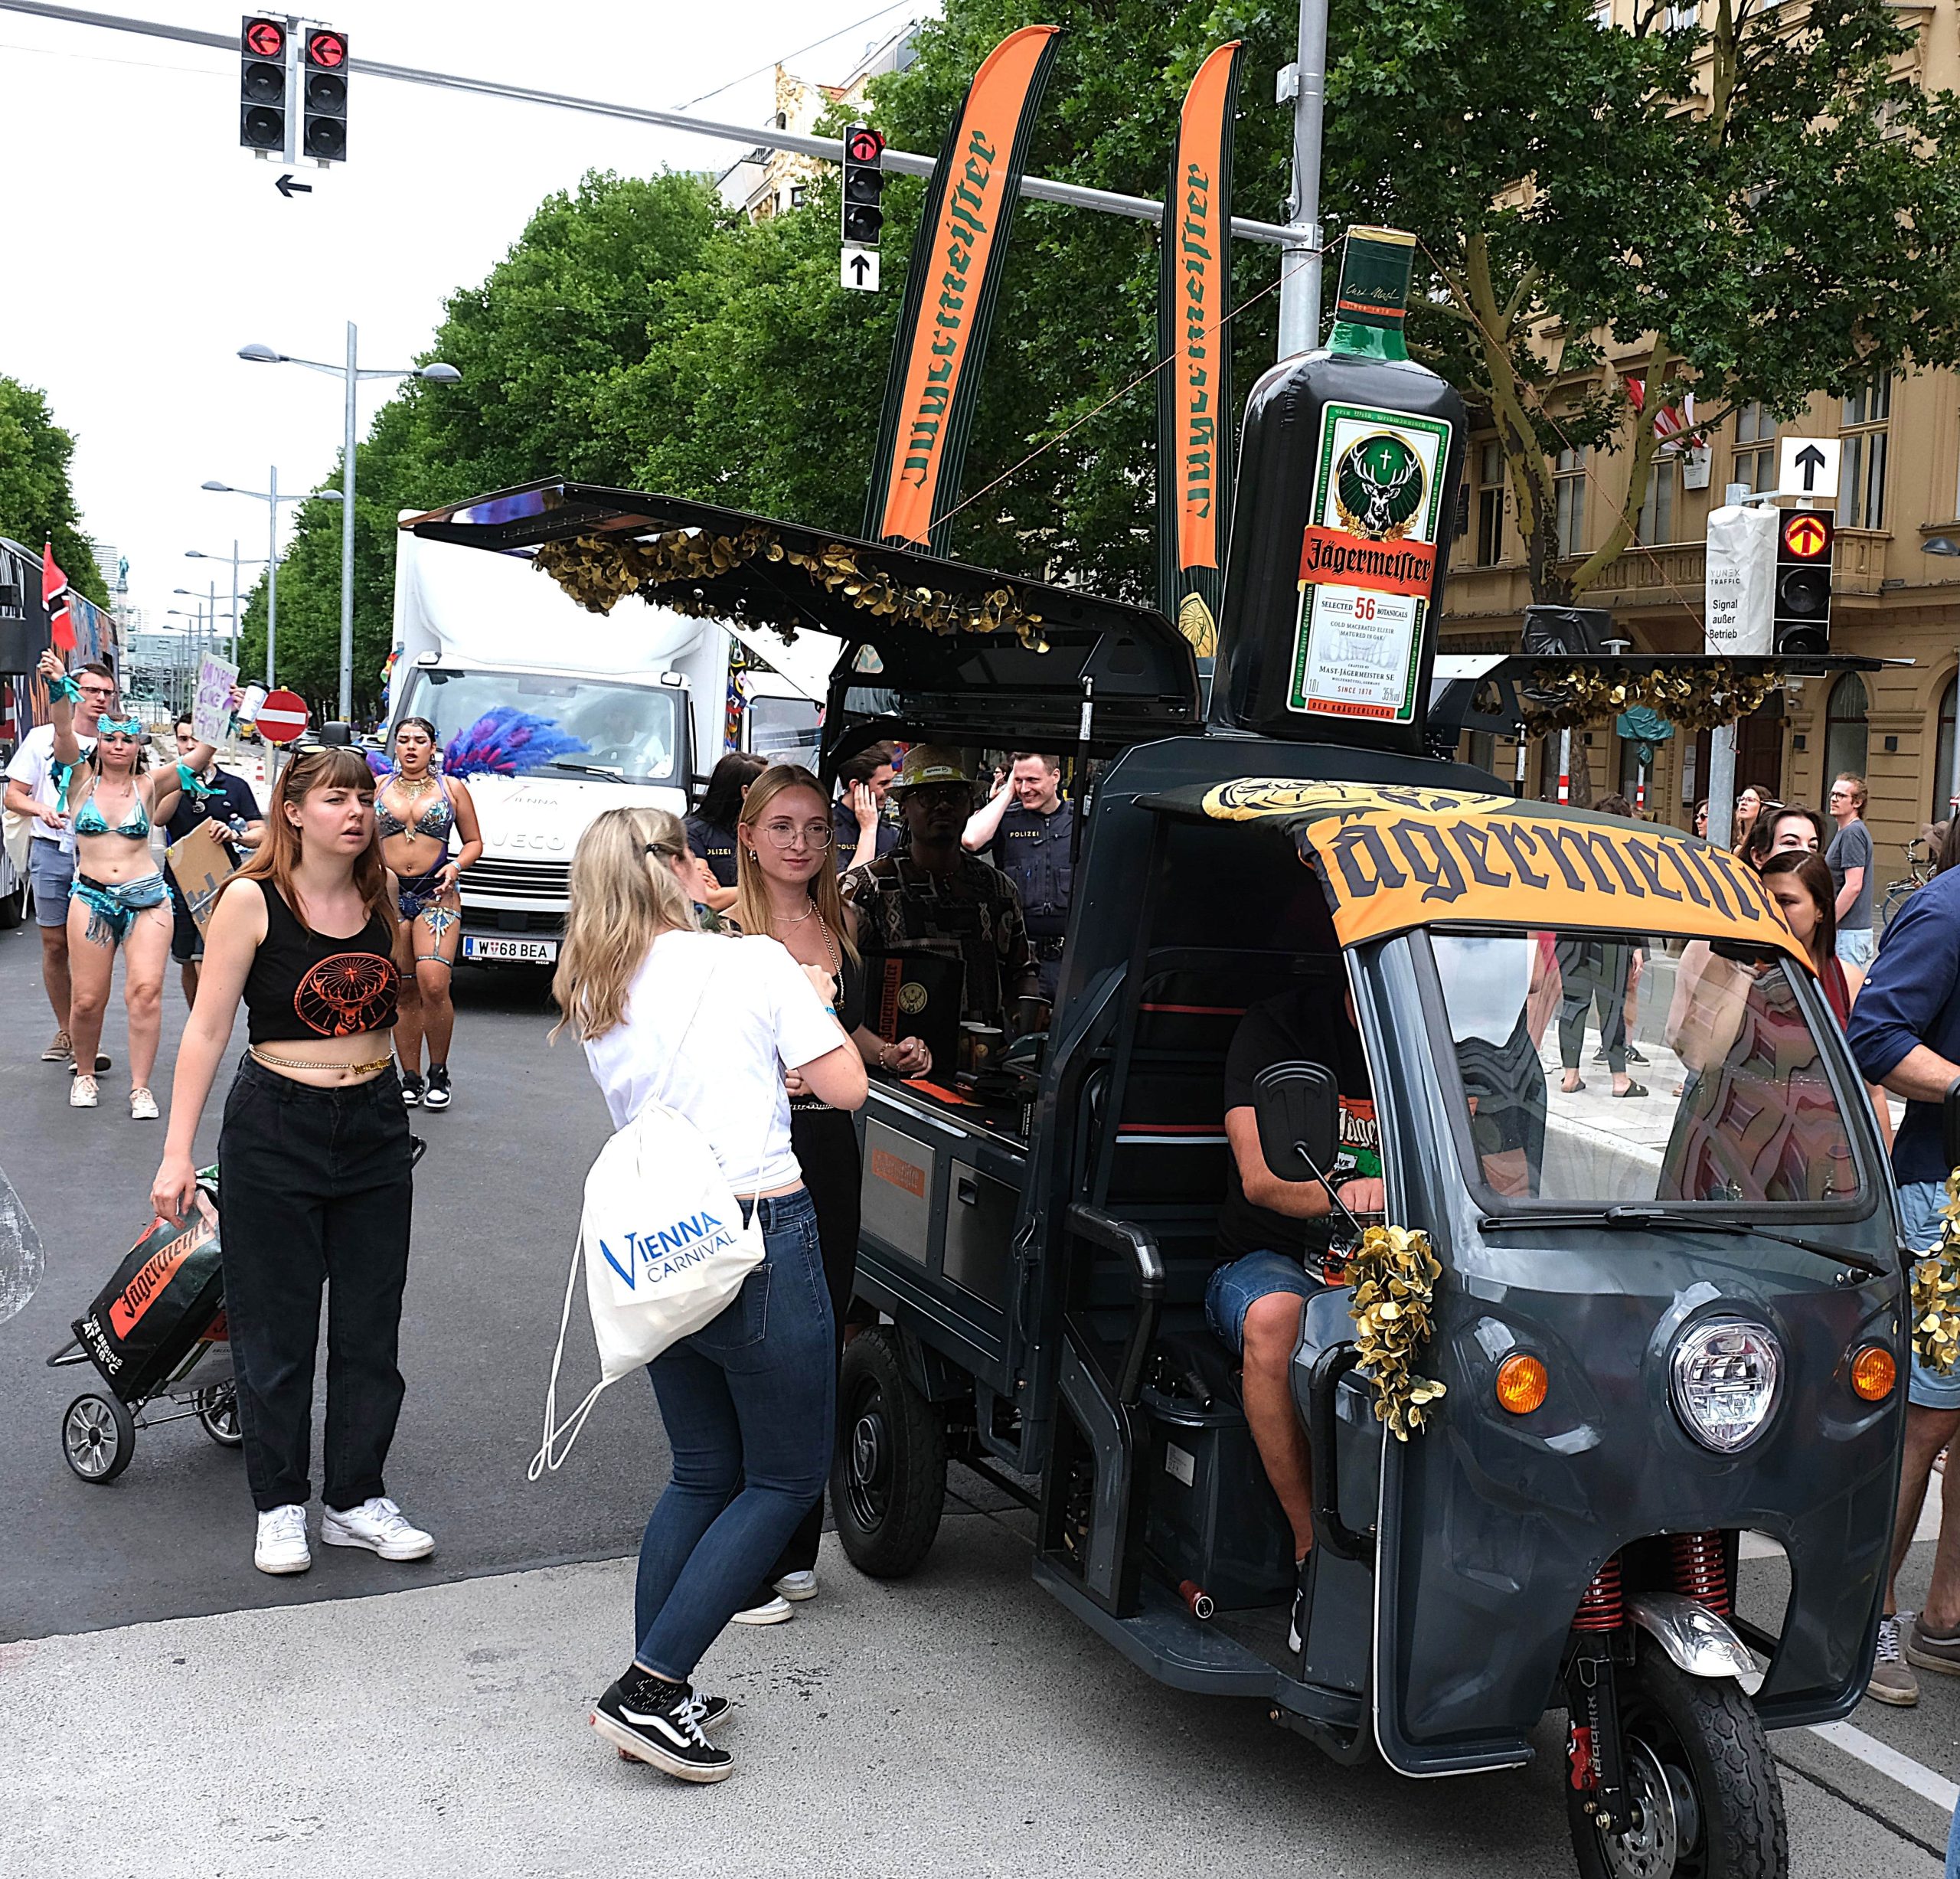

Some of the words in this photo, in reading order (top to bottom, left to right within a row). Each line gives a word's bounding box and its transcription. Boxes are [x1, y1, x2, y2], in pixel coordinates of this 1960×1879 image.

[1307, 537, 1432, 585] Jägermeister
[1710, 568, 1741, 578] YUNEX
[1321, 600, 1354, 611] SELECTED
[1354, 596, 1376, 621] 56
[1377, 608, 1408, 619] BOTANICALS
[1712, 599, 1738, 612] Signal
[1712, 614, 1736, 625] außer
[1340, 630, 1366, 639] MATURED
[1347, 623, 1377, 632] MACERATED
[1709, 629, 1738, 639] Betrieb
[1386, 673, 1395, 681] SE
[1337, 685, 1356, 694] SINCE
[1312, 701, 1328, 710] DER
[1331, 704, 1391, 717] KRÄUTERLIKÖR
[479, 941, 489, 955] W
[499, 943, 517, 956] 68
[520, 943, 547, 959] BEA
[599, 1211, 723, 1291] VIENNA
[647, 1231, 737, 1283] CARNIVAL
[82, 1322, 96, 1339] AT
[93, 1341, 119, 1375] -18°C
[97, 1333, 123, 1367] BEGINS
